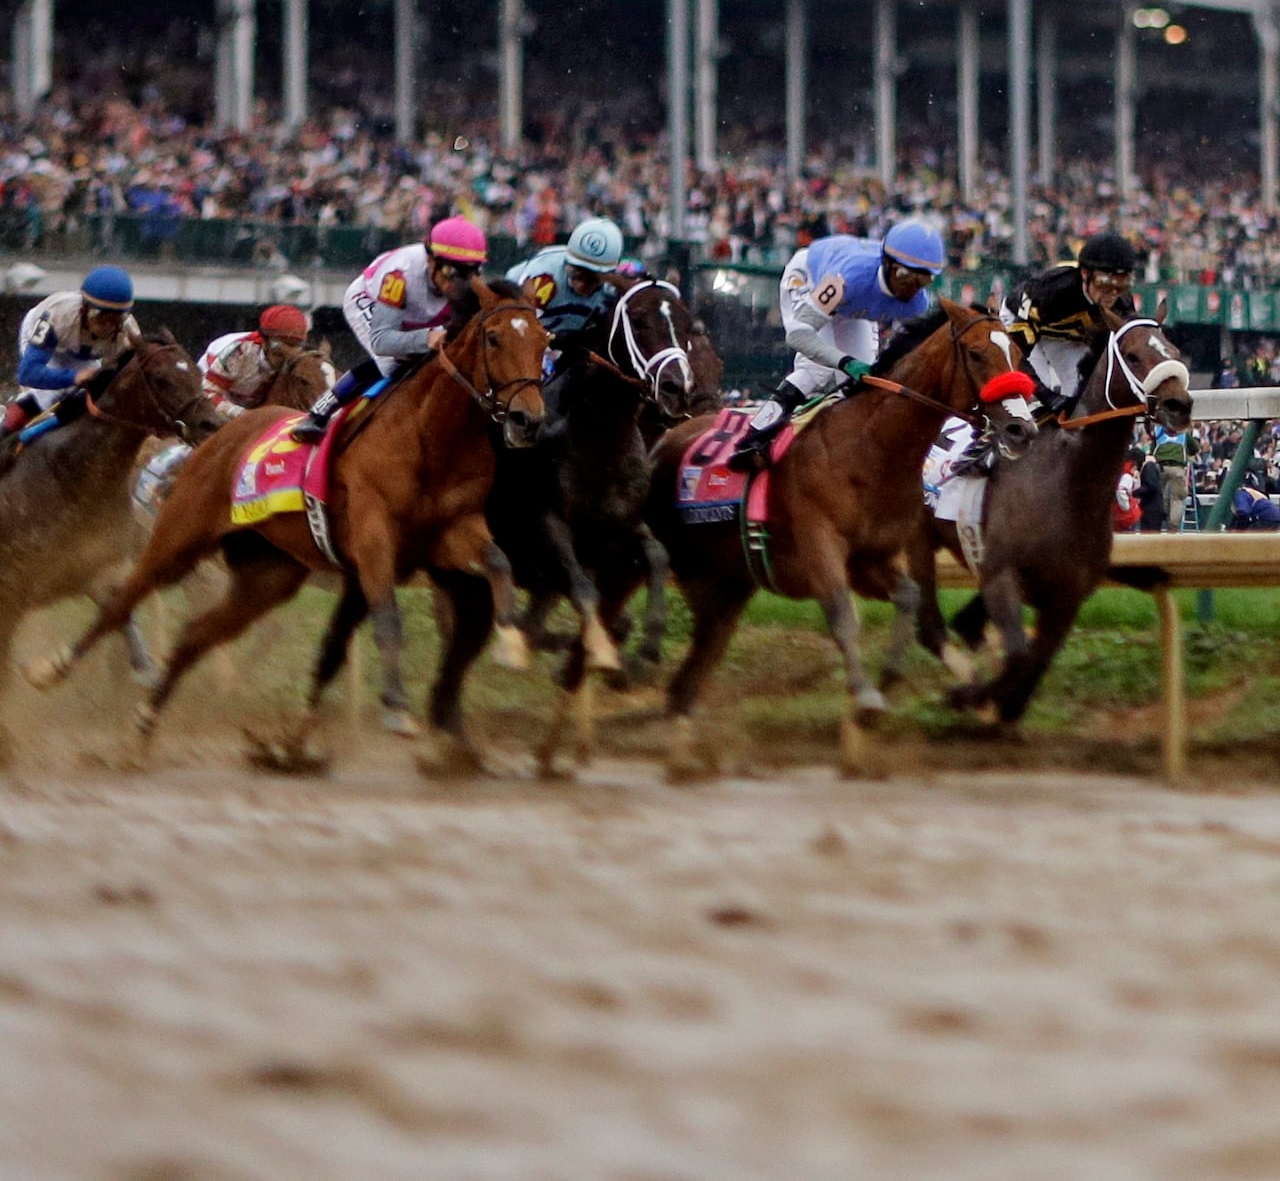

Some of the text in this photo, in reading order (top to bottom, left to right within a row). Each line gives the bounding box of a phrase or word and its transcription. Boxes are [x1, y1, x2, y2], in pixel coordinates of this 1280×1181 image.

[381, 274, 406, 303] 20
[818, 284, 836, 305] 8
[689, 410, 750, 466] 8
